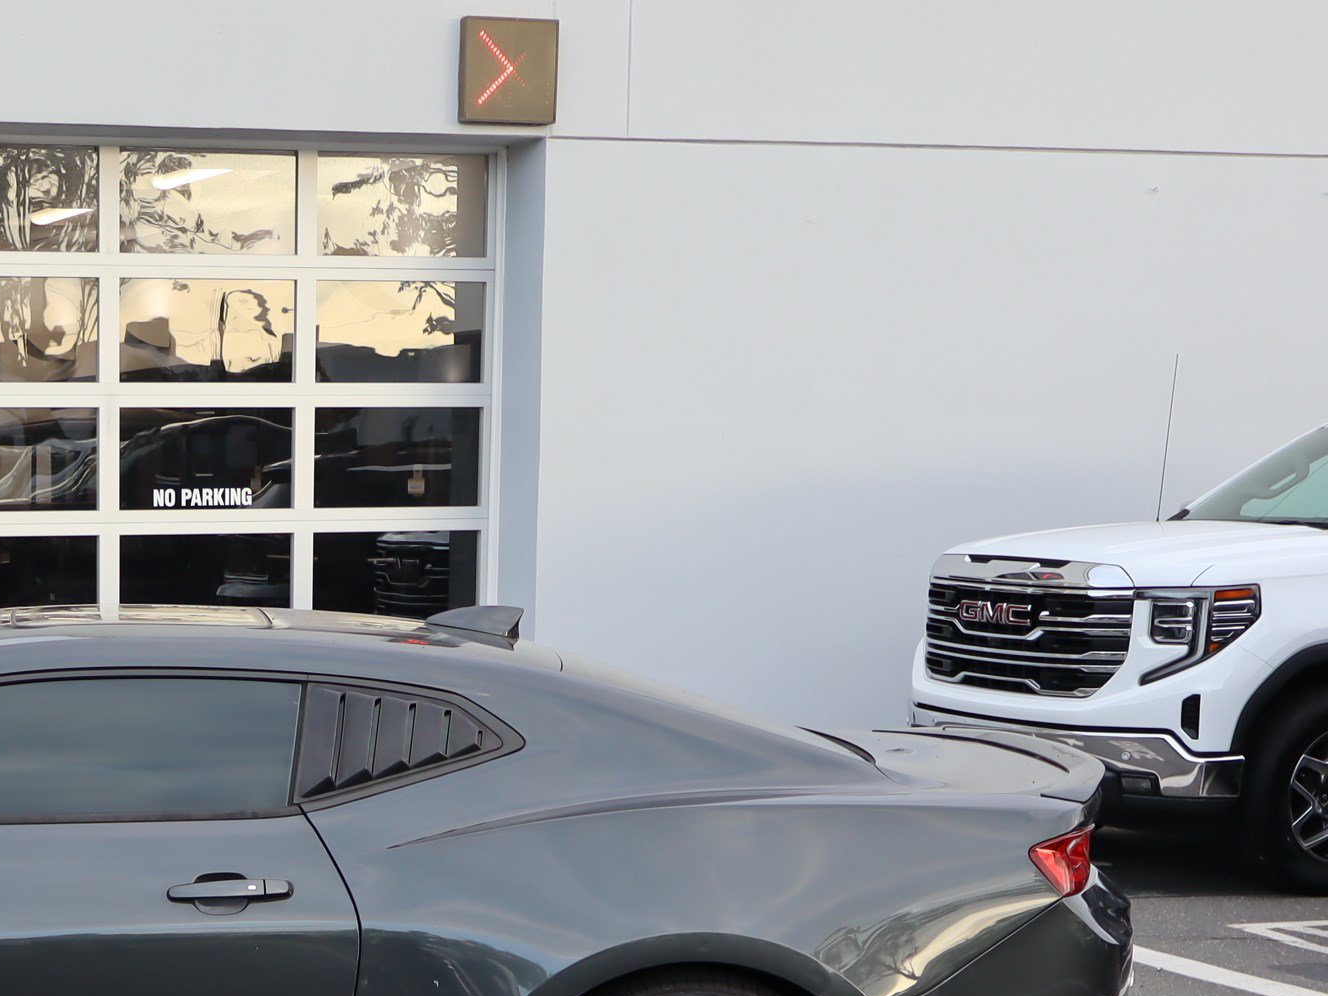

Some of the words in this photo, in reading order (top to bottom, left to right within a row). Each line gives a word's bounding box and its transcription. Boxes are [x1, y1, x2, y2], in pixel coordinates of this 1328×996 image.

[153, 488, 176, 507] NO
[181, 487, 253, 506] PARKING
[959, 600, 1032, 626] GMC
